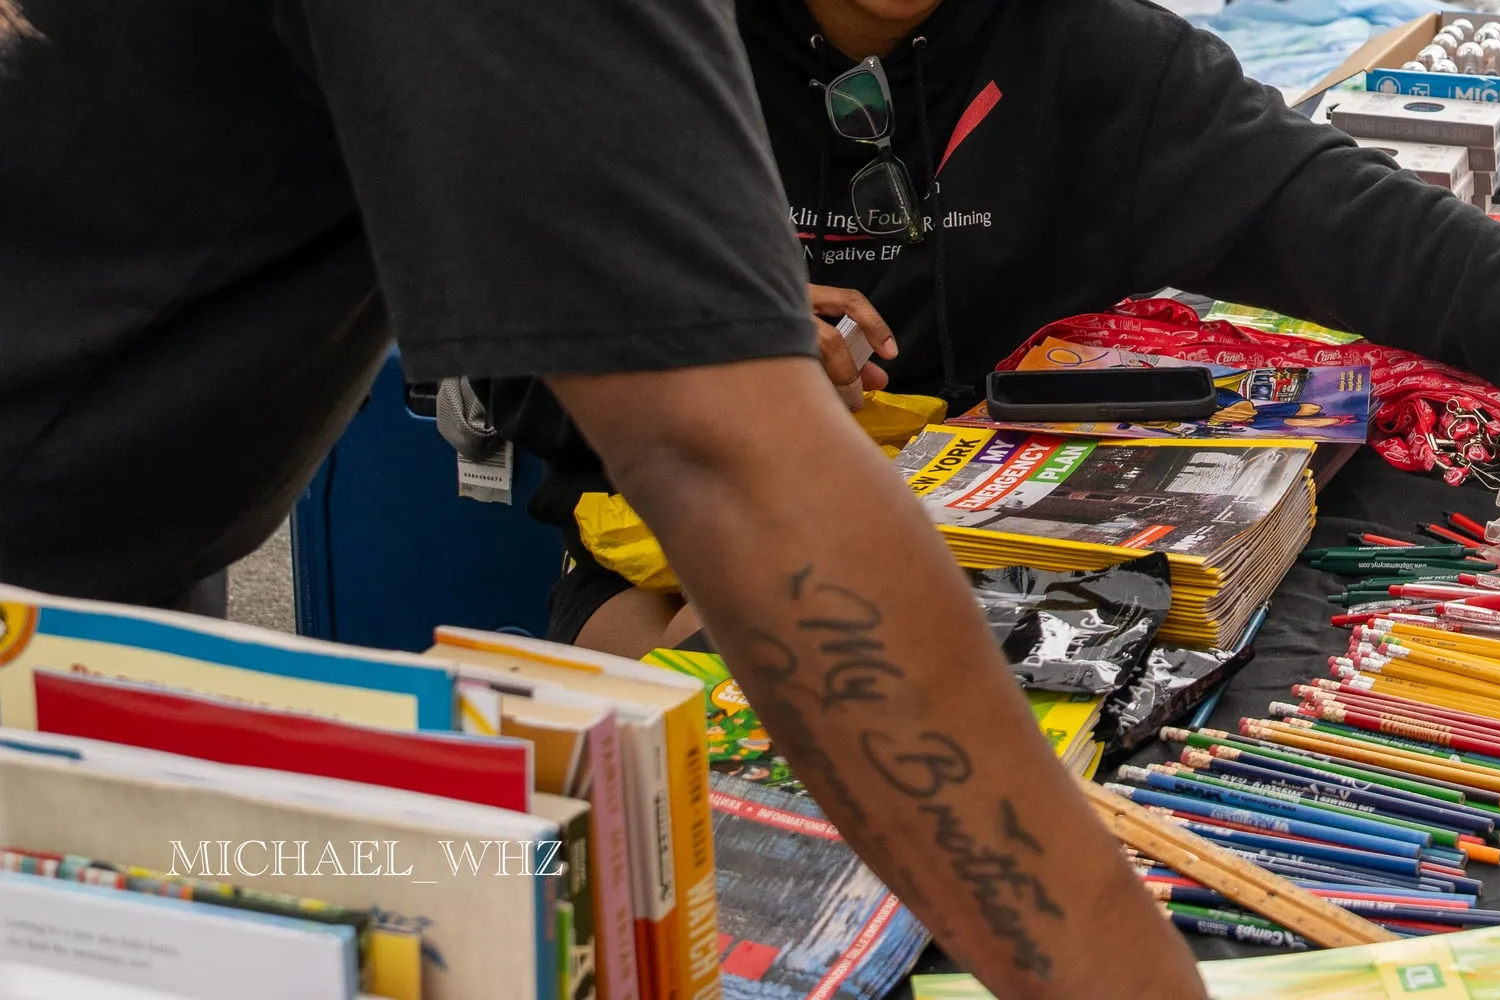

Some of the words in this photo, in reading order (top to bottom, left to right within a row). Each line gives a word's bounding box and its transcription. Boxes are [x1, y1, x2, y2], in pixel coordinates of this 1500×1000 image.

[1344, 117, 1377, 132] PHONE
[1378, 119, 1413, 135] HOLDER
[1416, 123, 1440, 137] RING
[1450, 126, 1481, 142] STAND
[1215, 349, 1247, 366] Cane's
[1314, 348, 1343, 366] Cane's
[979, 439, 1016, 462] MY
[1036, 445, 1090, 481] PLAN
[911, 476, 940, 493] EW
[928, 437, 981, 474] YORK
[954, 442, 1051, 509] EMERGENCY
[686, 871, 721, 982] WATCH
[1236, 923, 1284, 946] Camps
